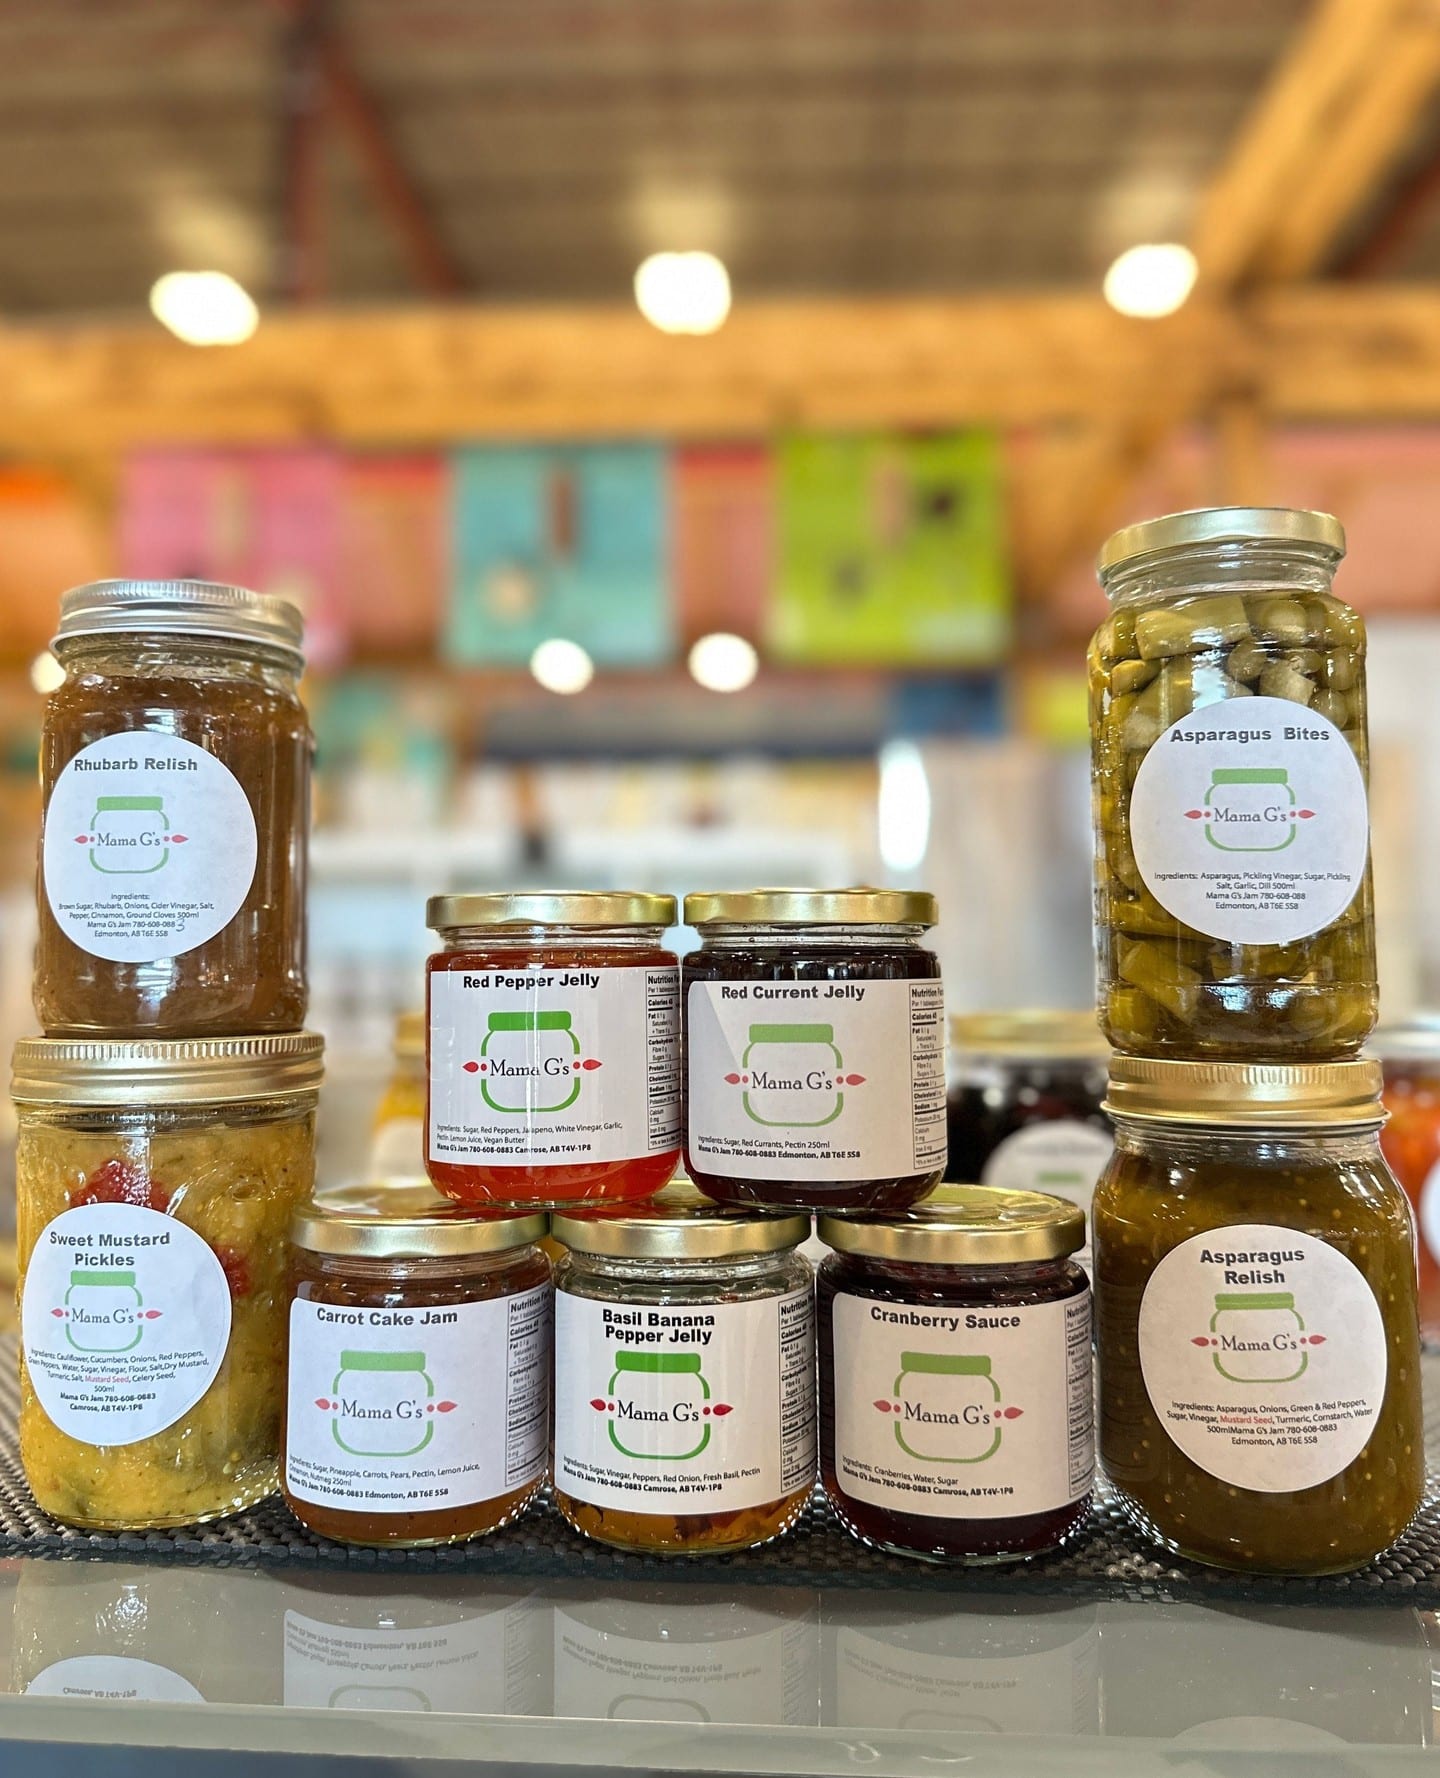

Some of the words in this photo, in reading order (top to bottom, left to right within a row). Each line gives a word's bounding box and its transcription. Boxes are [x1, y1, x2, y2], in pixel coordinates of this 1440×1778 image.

[1171, 729, 1271, 744] Asparagus
[1284, 727, 1329, 740] Bites
[74, 759, 138, 771] Rhubarb
[144, 758, 197, 771] Relish
[1214, 808, 1260, 822] Mama
[1264, 807, 1286, 821] G's
[97, 833, 137, 846] Mama
[140, 832, 160, 846] G's
[171, 903, 199, 911] Vinegar,
[463, 976, 489, 988] Red
[495, 975, 554, 990] Pepper
[559, 973, 599, 988] Jelly
[722, 986, 747, 998] Red
[753, 986, 818, 998] Current
[824, 986, 865, 1001] Jelly
[490, 1060, 540, 1076] Mama
[544, 1058, 569, 1075] G's
[752, 1072, 801, 1089] Mama
[806, 1071, 832, 1089] G's
[494, 1126, 520, 1134] Peppers,
[555, 1124, 575, 1132] White
[576, 1124, 602, 1133] Vinegar,
[604, 1122, 622, 1130] Garlic,
[484, 1136, 503, 1144] Vegan
[754, 1140, 783, 1148] Currants,
[562, 1144, 591, 1152] T4V-1P8
[50, 1232, 93, 1246] Sweet
[99, 1232, 170, 1246] Mustard
[75, 1253, 134, 1266] Pickles
[1200, 1249, 1304, 1265] Asparagus
[1225, 1270, 1285, 1284] Relish
[72, 1309, 110, 1323] Mama
[113, 1310, 134, 1323] G's
[317, 1308, 364, 1325] Carrot
[370, 1311, 414, 1326] Cake
[420, 1310, 458, 1325] Jam
[603, 1309, 641, 1325] Basil
[648, 1313, 715, 1326] Banana
[871, 1307, 959, 1331] Cranberry
[966, 1315, 1020, 1328] Sauce
[605, 1326, 663, 1344] Pepper
[669, 1329, 712, 1344] Jelly
[1221, 1335, 1270, 1351] Mama
[1273, 1334, 1297, 1350] G's
[90, 1355, 128, 1363] Cucumbers,
[130, 1355, 157, 1363] Onions,
[174, 1351, 203, 1360] Peppers,
[81, 1365, 99, 1373] Sugar,
[100, 1366, 127, 1374] Vinegar,
[179, 1358, 209, 1368] Mustard,
[132, 1374, 155, 1382] Celery
[60, 1392, 78, 1400] Mama
[342, 1400, 392, 1419] Mama
[396, 1400, 422, 1419] G's
[617, 1400, 668, 1421] Mama
[673, 1403, 699, 1421] G's
[904, 1401, 959, 1424] Mama
[963, 1405, 990, 1424] G's
[1172, 1401, 1214, 1412] Ingredients:
[1217, 1405, 1258, 1414] Asparagus,
[1260, 1405, 1289, 1414] Onions,
[1315, 1403, 1321, 1411] &
[1338, 1399, 1366, 1409] Peppers,
[1167, 1411, 1188, 1421] Sugar,
[1189, 1414, 1219, 1424] Vinegar,
[1220, 1415, 1251, 1424] Mustard
[1276, 1415, 1311, 1424] Turmeric,
[1313, 1412, 1353, 1422] Cornstarch,
[1354, 1408, 1373, 1417] Water
[1269, 1426, 1284, 1434] Jam
[1232, 1437, 1274, 1446] Edmonton,
[330, 1467, 361, 1477] Pineapple,
[363, 1470, 389, 1479] Carrots,
[391, 1471, 410, 1479] Pears,
[412, 1470, 436, 1478] Pectin,
[438, 1467, 461, 1476] Lemon
[462, 1464, 480, 1473] Juice,
[607, 1468, 631, 1480] Vinegar,
[633, 1473, 661, 1482] Peppers,
[679, 1474, 701, 1482] Onion,
[704, 1473, 722, 1481] Fresh
[724, 1471, 739, 1480] Basil,
[741, 1467, 760, 1476] Pectin
[875, 1466, 912, 1481] Cranberries,
[913, 1473, 935, 1484] Water,
[937, 1477, 958, 1486] Sugar
[333, 1477, 351, 1486] 250ml
[644, 1484, 677, 1493] Camrose,
[691, 1484, 722, 1492] T4V-1P8
[365, 1491, 404, 1499] Edmonton,
